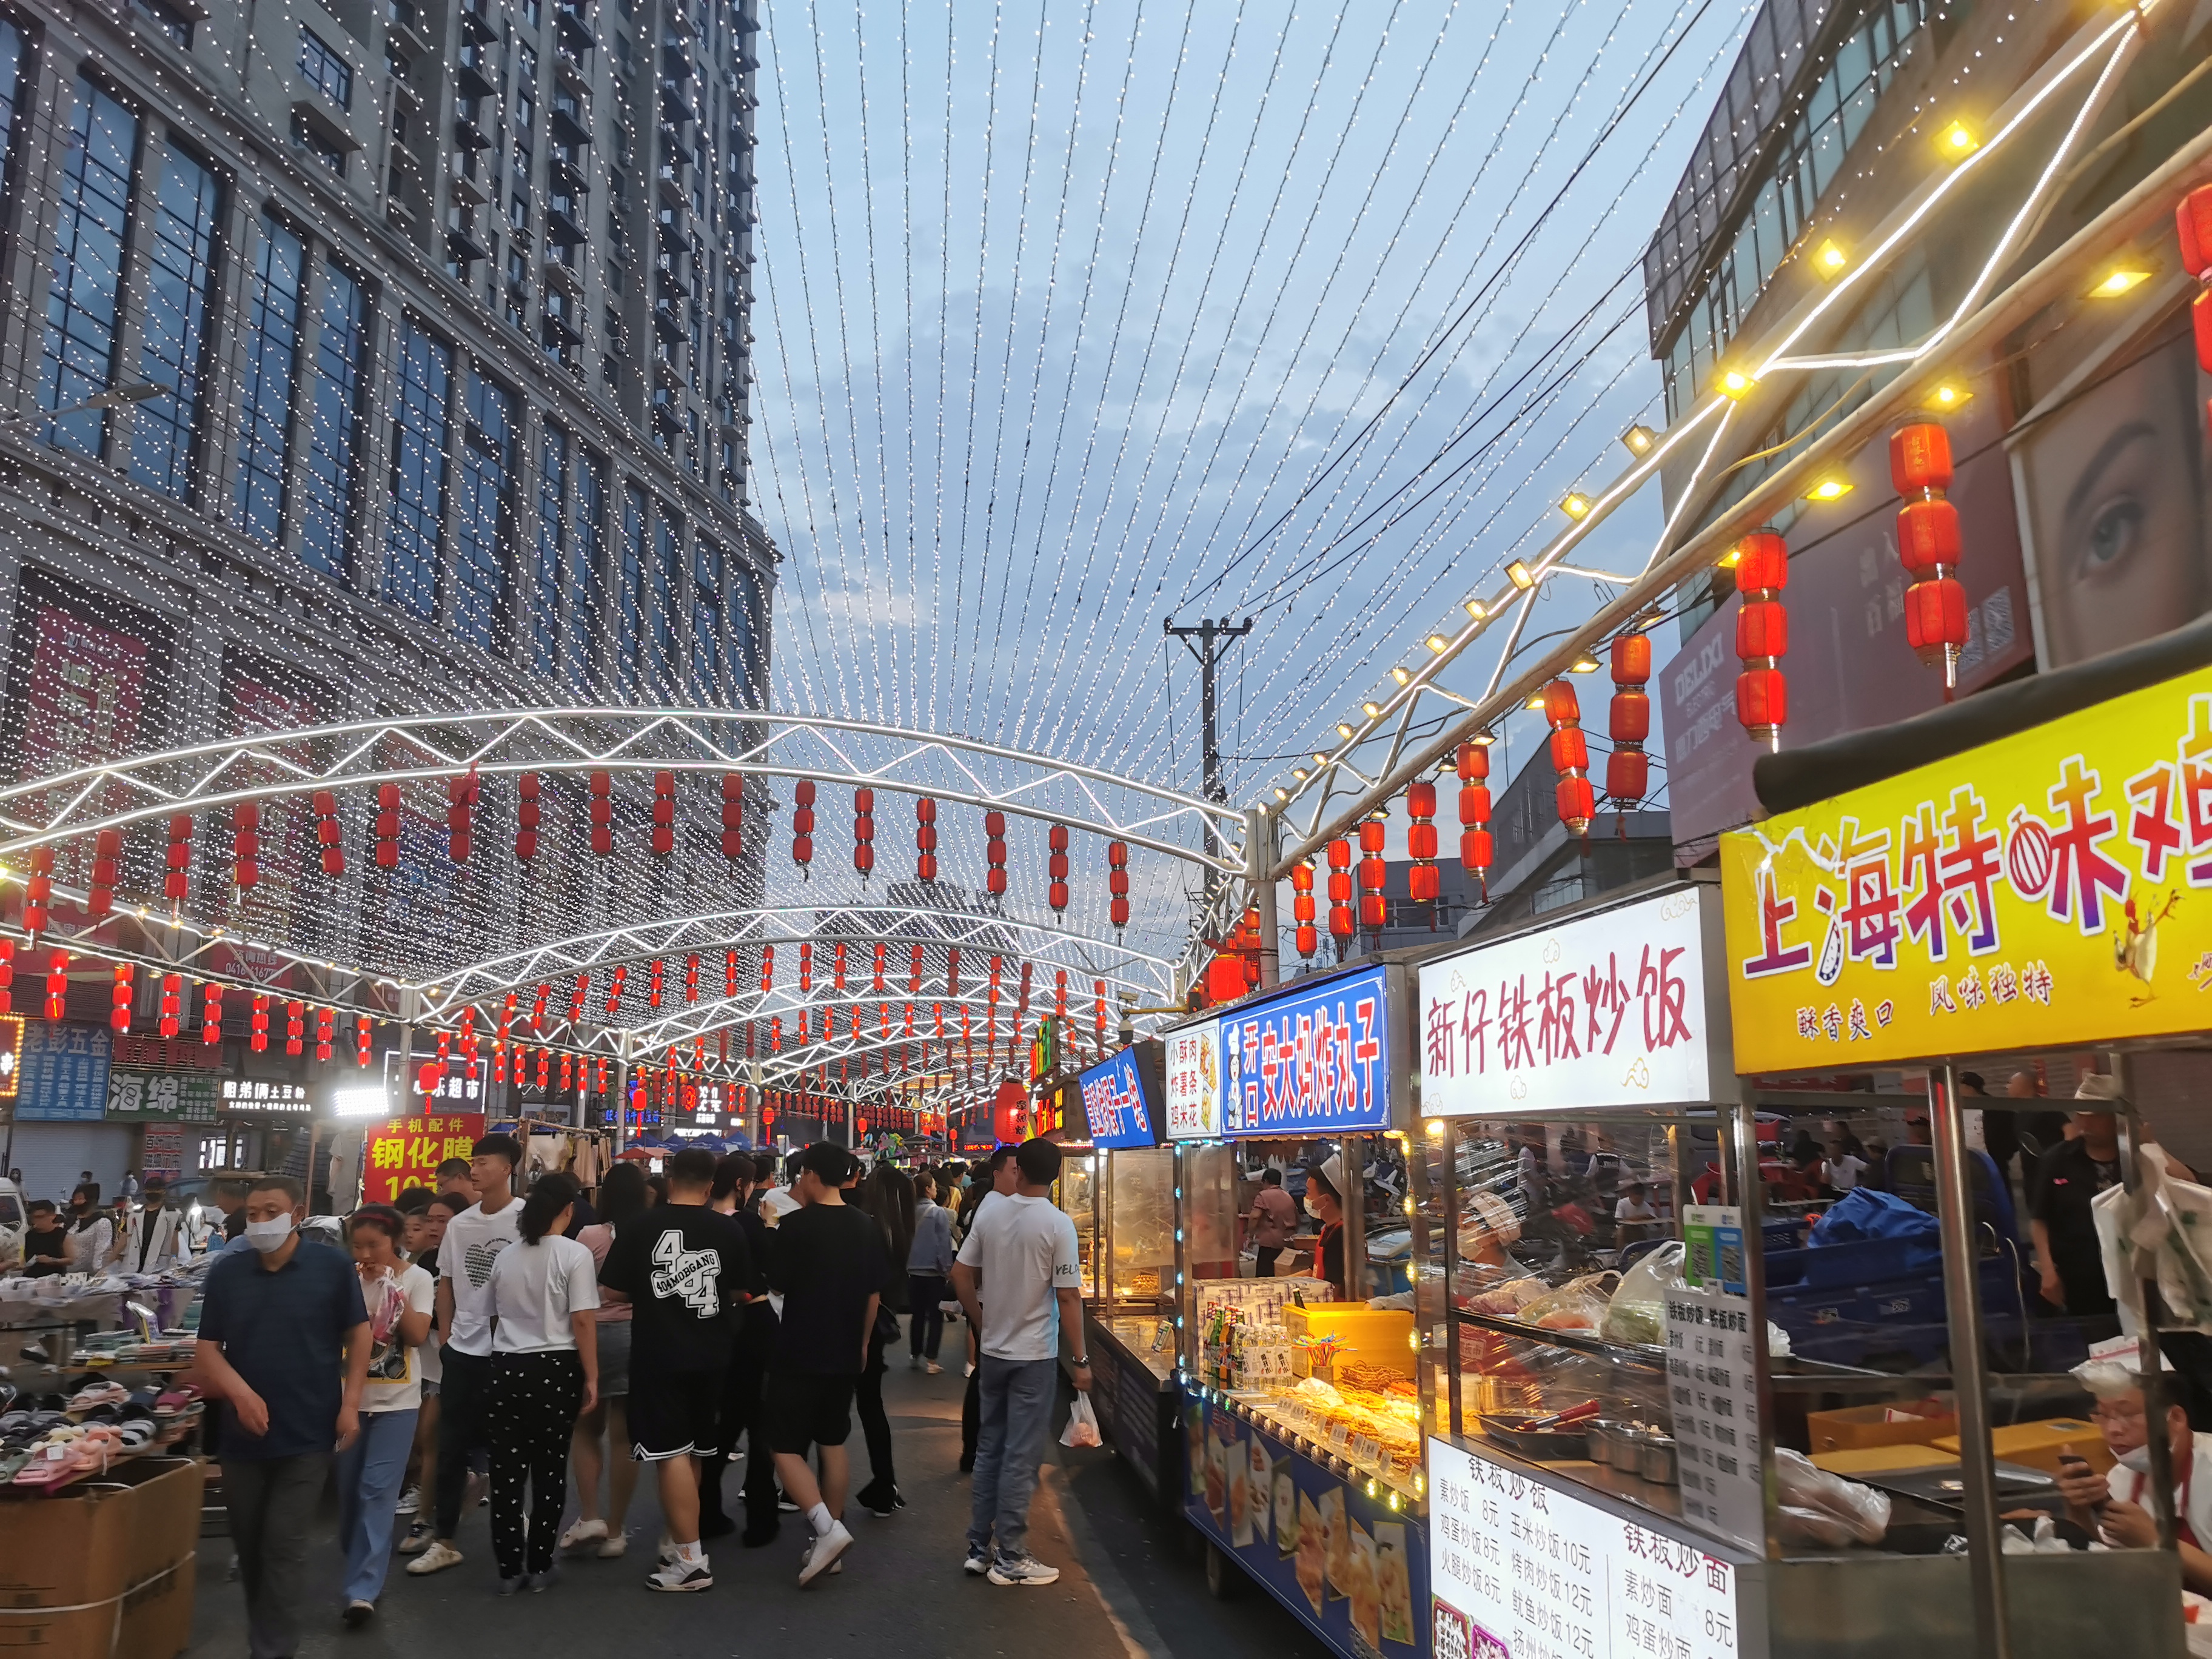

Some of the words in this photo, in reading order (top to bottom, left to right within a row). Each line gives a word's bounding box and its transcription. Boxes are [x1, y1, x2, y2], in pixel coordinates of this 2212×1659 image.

[1742, 692, 2212, 986] 上海特味鸡
[1929, 958, 2054, 1016] 风味独特
[1427, 943, 1692, 1079] 新仔铁板炒饭
[1796, 998, 1894, 1041] 酥香爽口
[1170, 1036, 1197, 1067] 小酥肉
[109, 1073, 180, 1114] 海绵
[223, 1081, 306, 1100] 姐弟俩土豆粉
[1171, 1069, 1197, 1098] 炸薯条
[387, 1118, 464, 1133] 手机配件
[1171, 1101, 1197, 1129] 鸡米花
[371, 1136, 475, 1170] 钢化膜
[1439, 1477, 1470, 1514] 素炒饭
[1482, 1499, 1500, 1528] 8元
[1469, 1455, 1549, 1515] 铁板炒饭
[1623, 1521, 1729, 1595] 铁板炒面
[1624, 1568, 1672, 1620] 素炒面
[1705, 1609, 1733, 1648] 8元
[1513, 1625, 1564, 1659] 扬州炒
